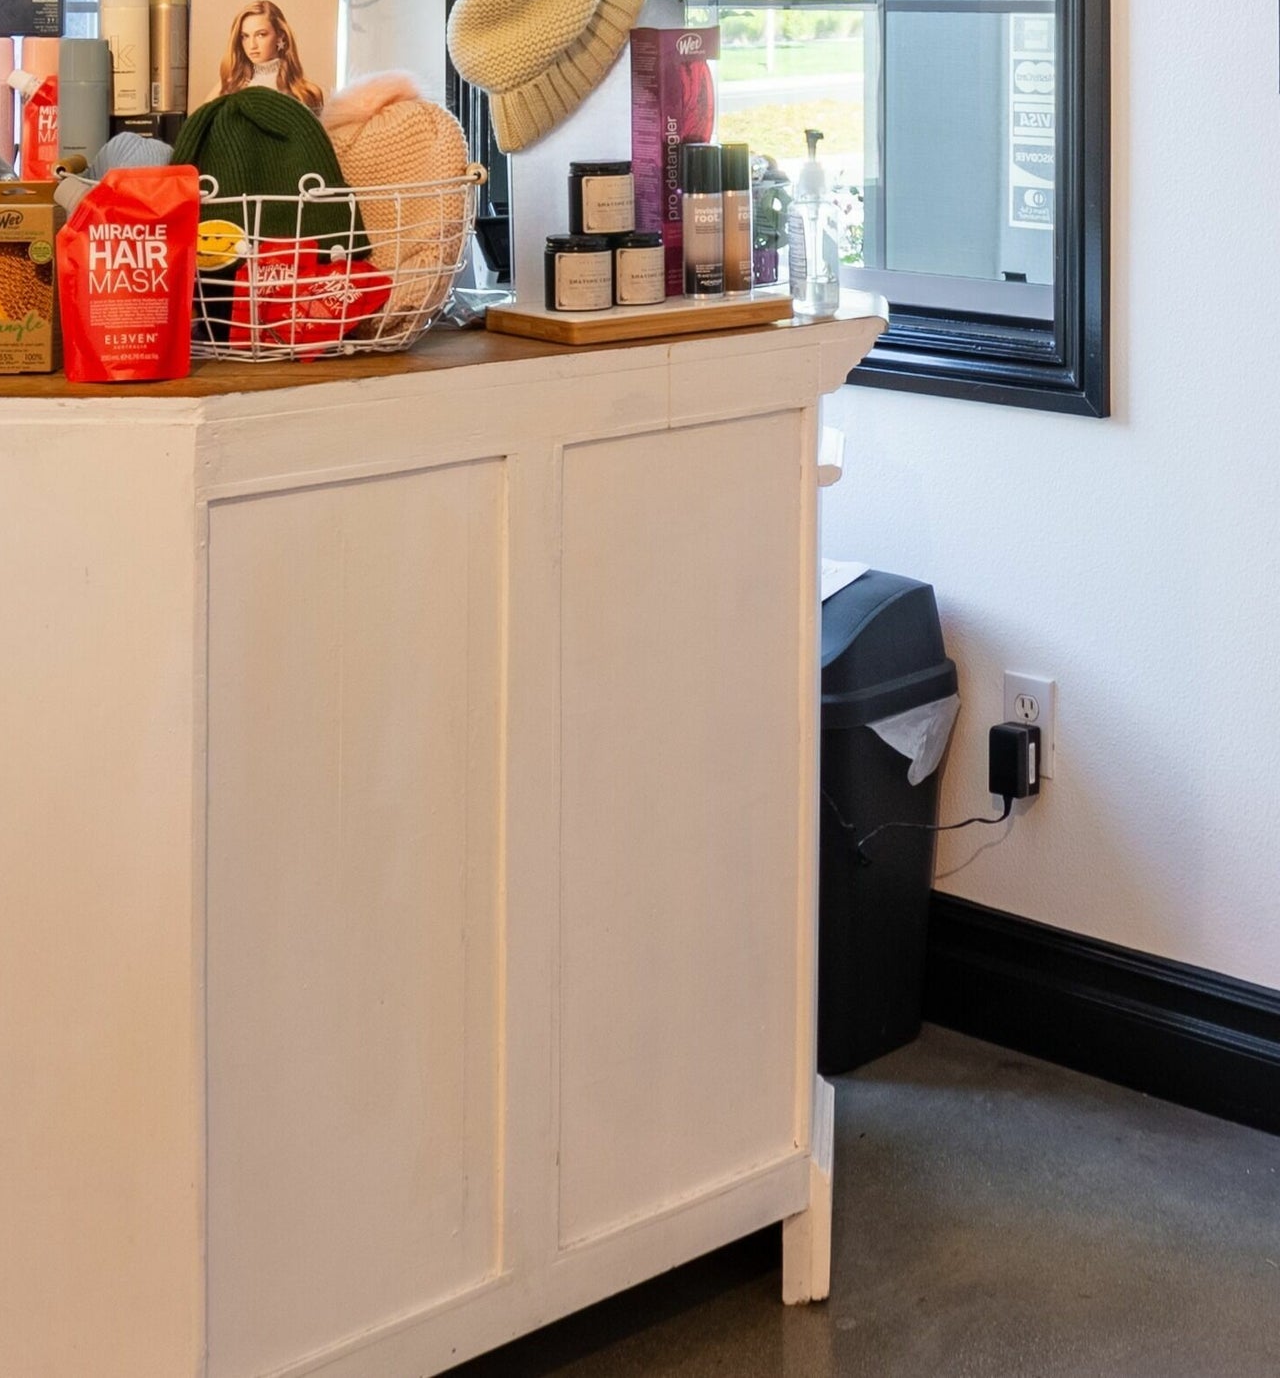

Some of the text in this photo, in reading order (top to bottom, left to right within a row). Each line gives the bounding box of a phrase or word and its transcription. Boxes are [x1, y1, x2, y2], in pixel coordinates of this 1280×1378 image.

[680, 36, 700, 55] Wet
[665, 115, 681, 221] pro detangler
[89, 224, 168, 240] MIRACLE
[89, 240, 169, 270] HAIR
[89, 269, 169, 294] MASK
[104, 333, 156, 345] ELEVEN
